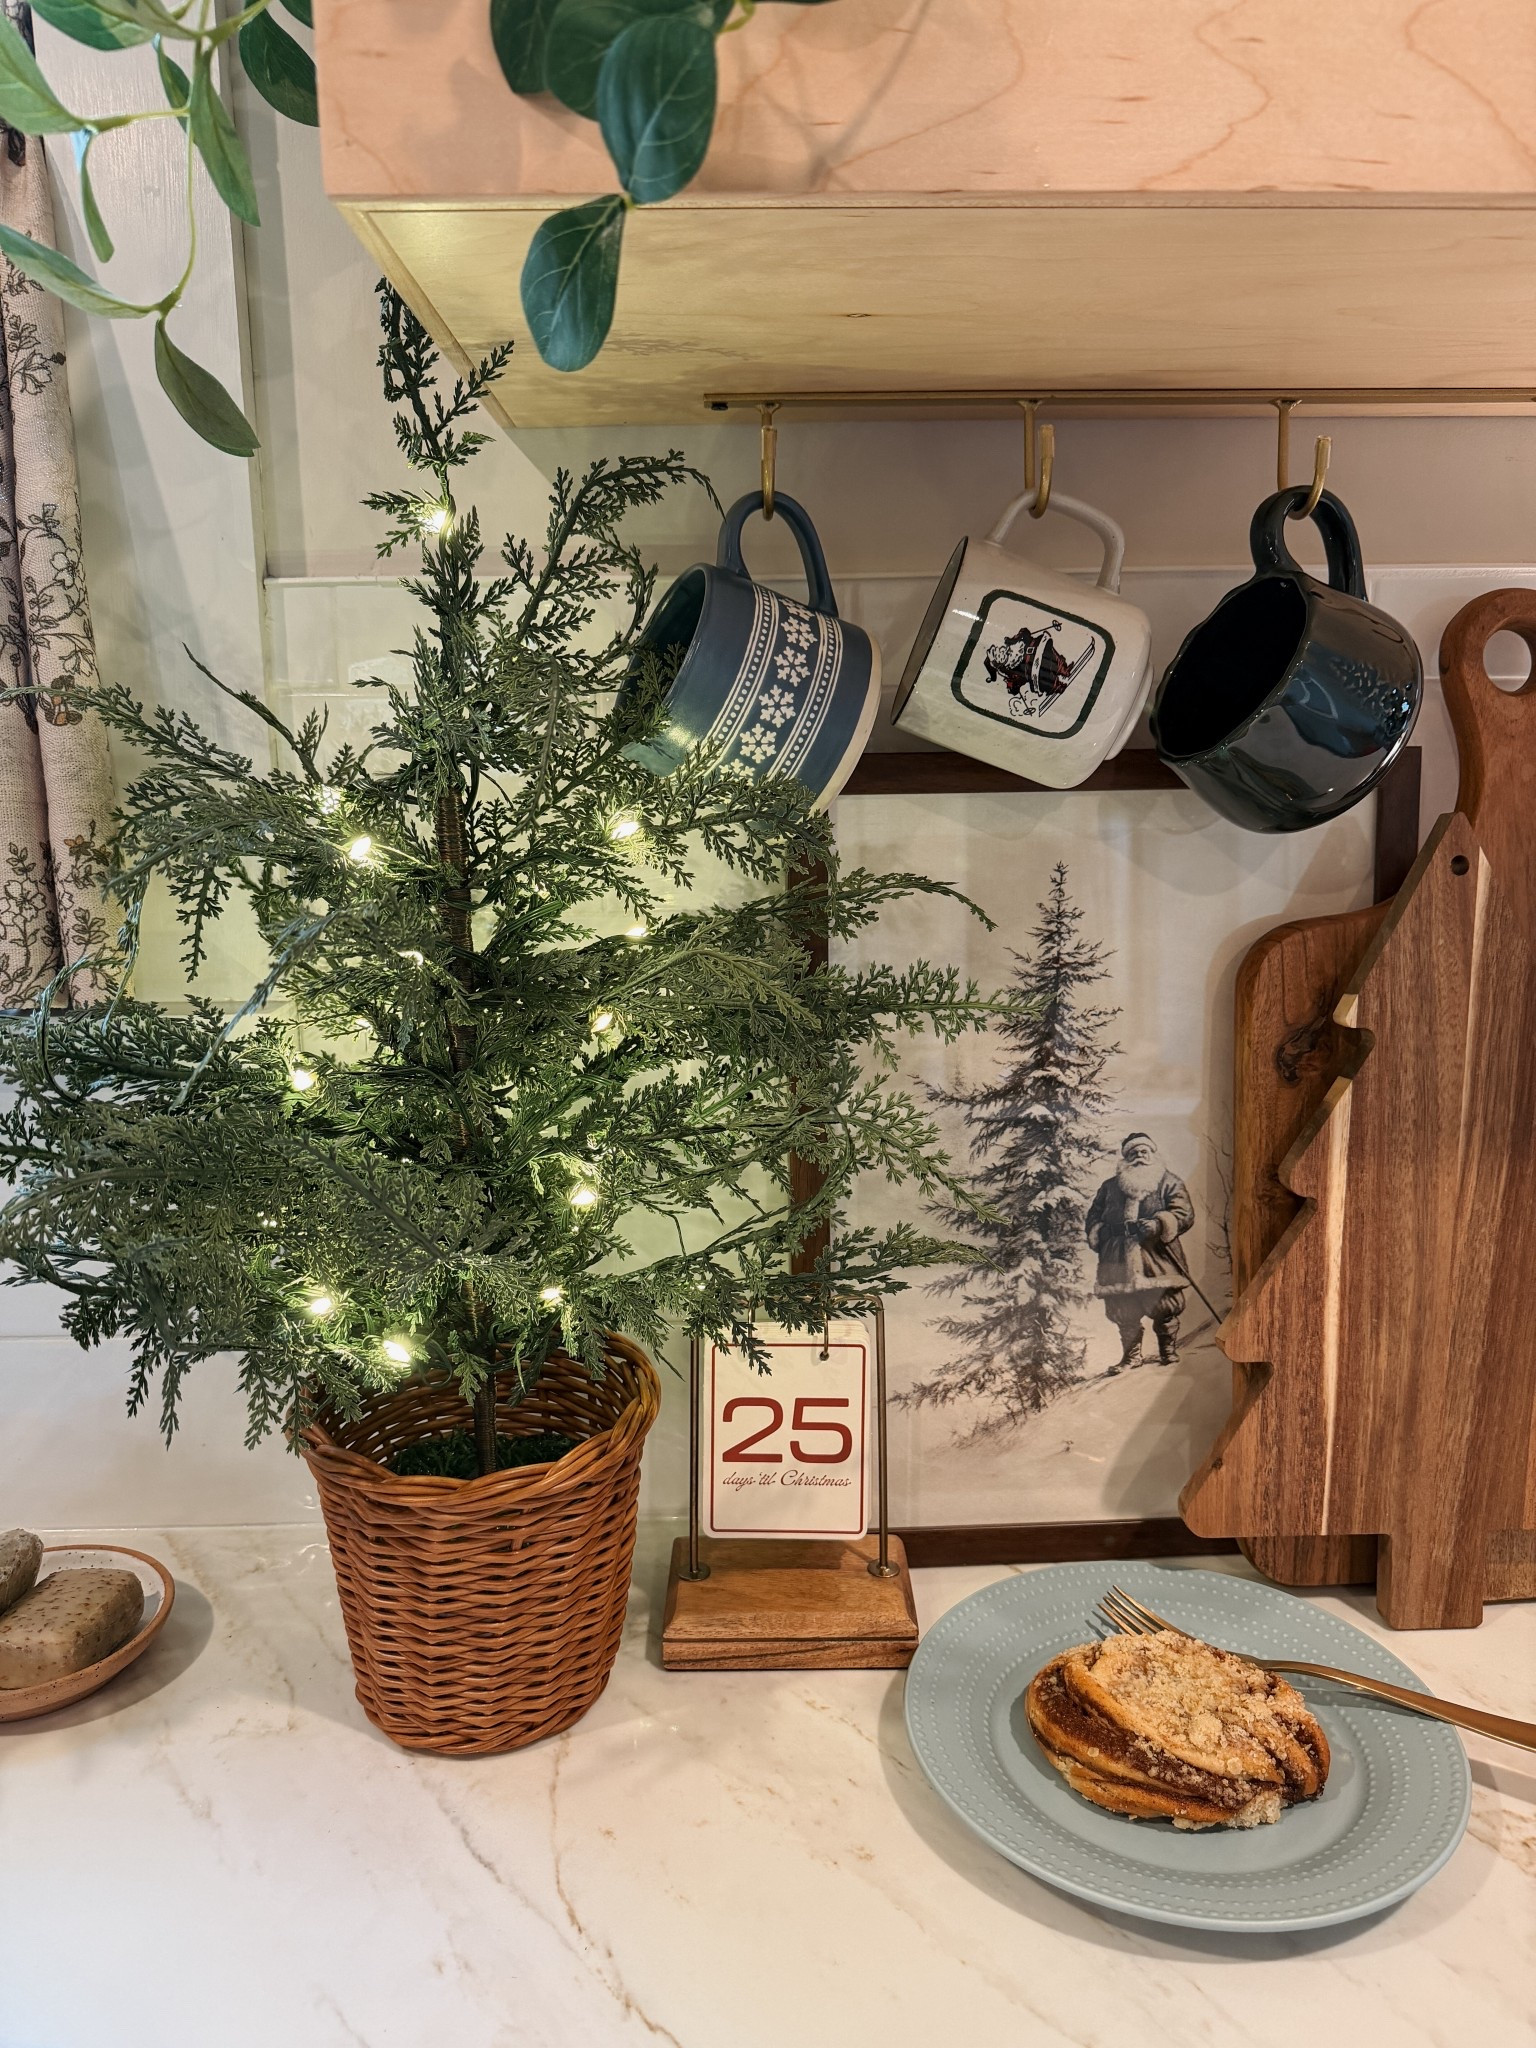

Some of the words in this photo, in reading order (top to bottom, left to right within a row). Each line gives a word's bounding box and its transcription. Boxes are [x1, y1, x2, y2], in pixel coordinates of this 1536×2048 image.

[722, 1396, 853, 1464] 25
[722, 1471, 756, 1492] days
[780, 1469, 852, 1487] Christmas
